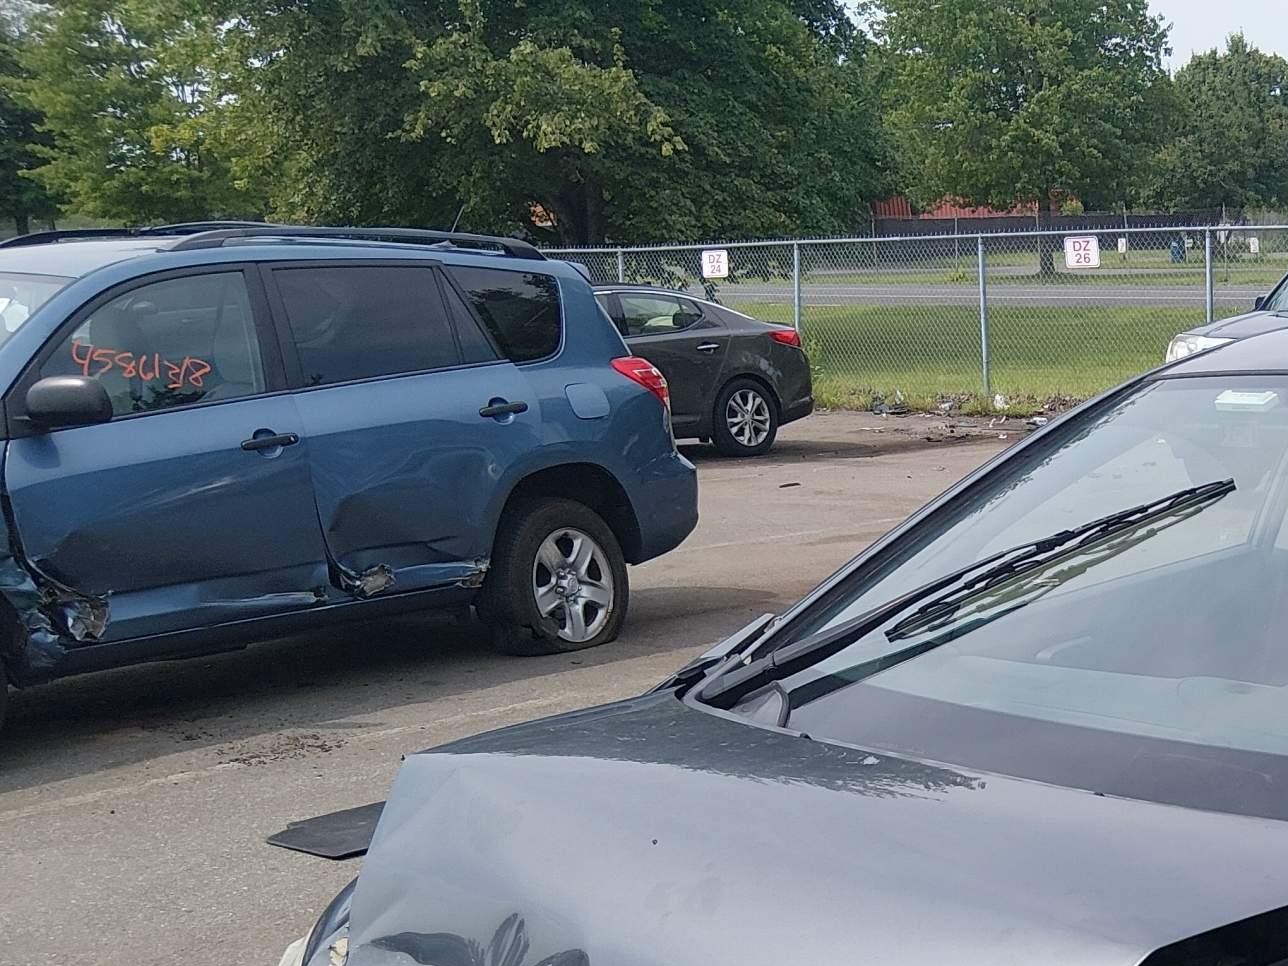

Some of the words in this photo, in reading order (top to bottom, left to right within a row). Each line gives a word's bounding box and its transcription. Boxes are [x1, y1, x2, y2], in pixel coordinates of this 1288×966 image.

[1072, 240, 1091, 252] DZ
[708, 254, 722, 264] DZ
[1074, 252, 1091, 264] 26
[710, 265, 721, 274] 24
